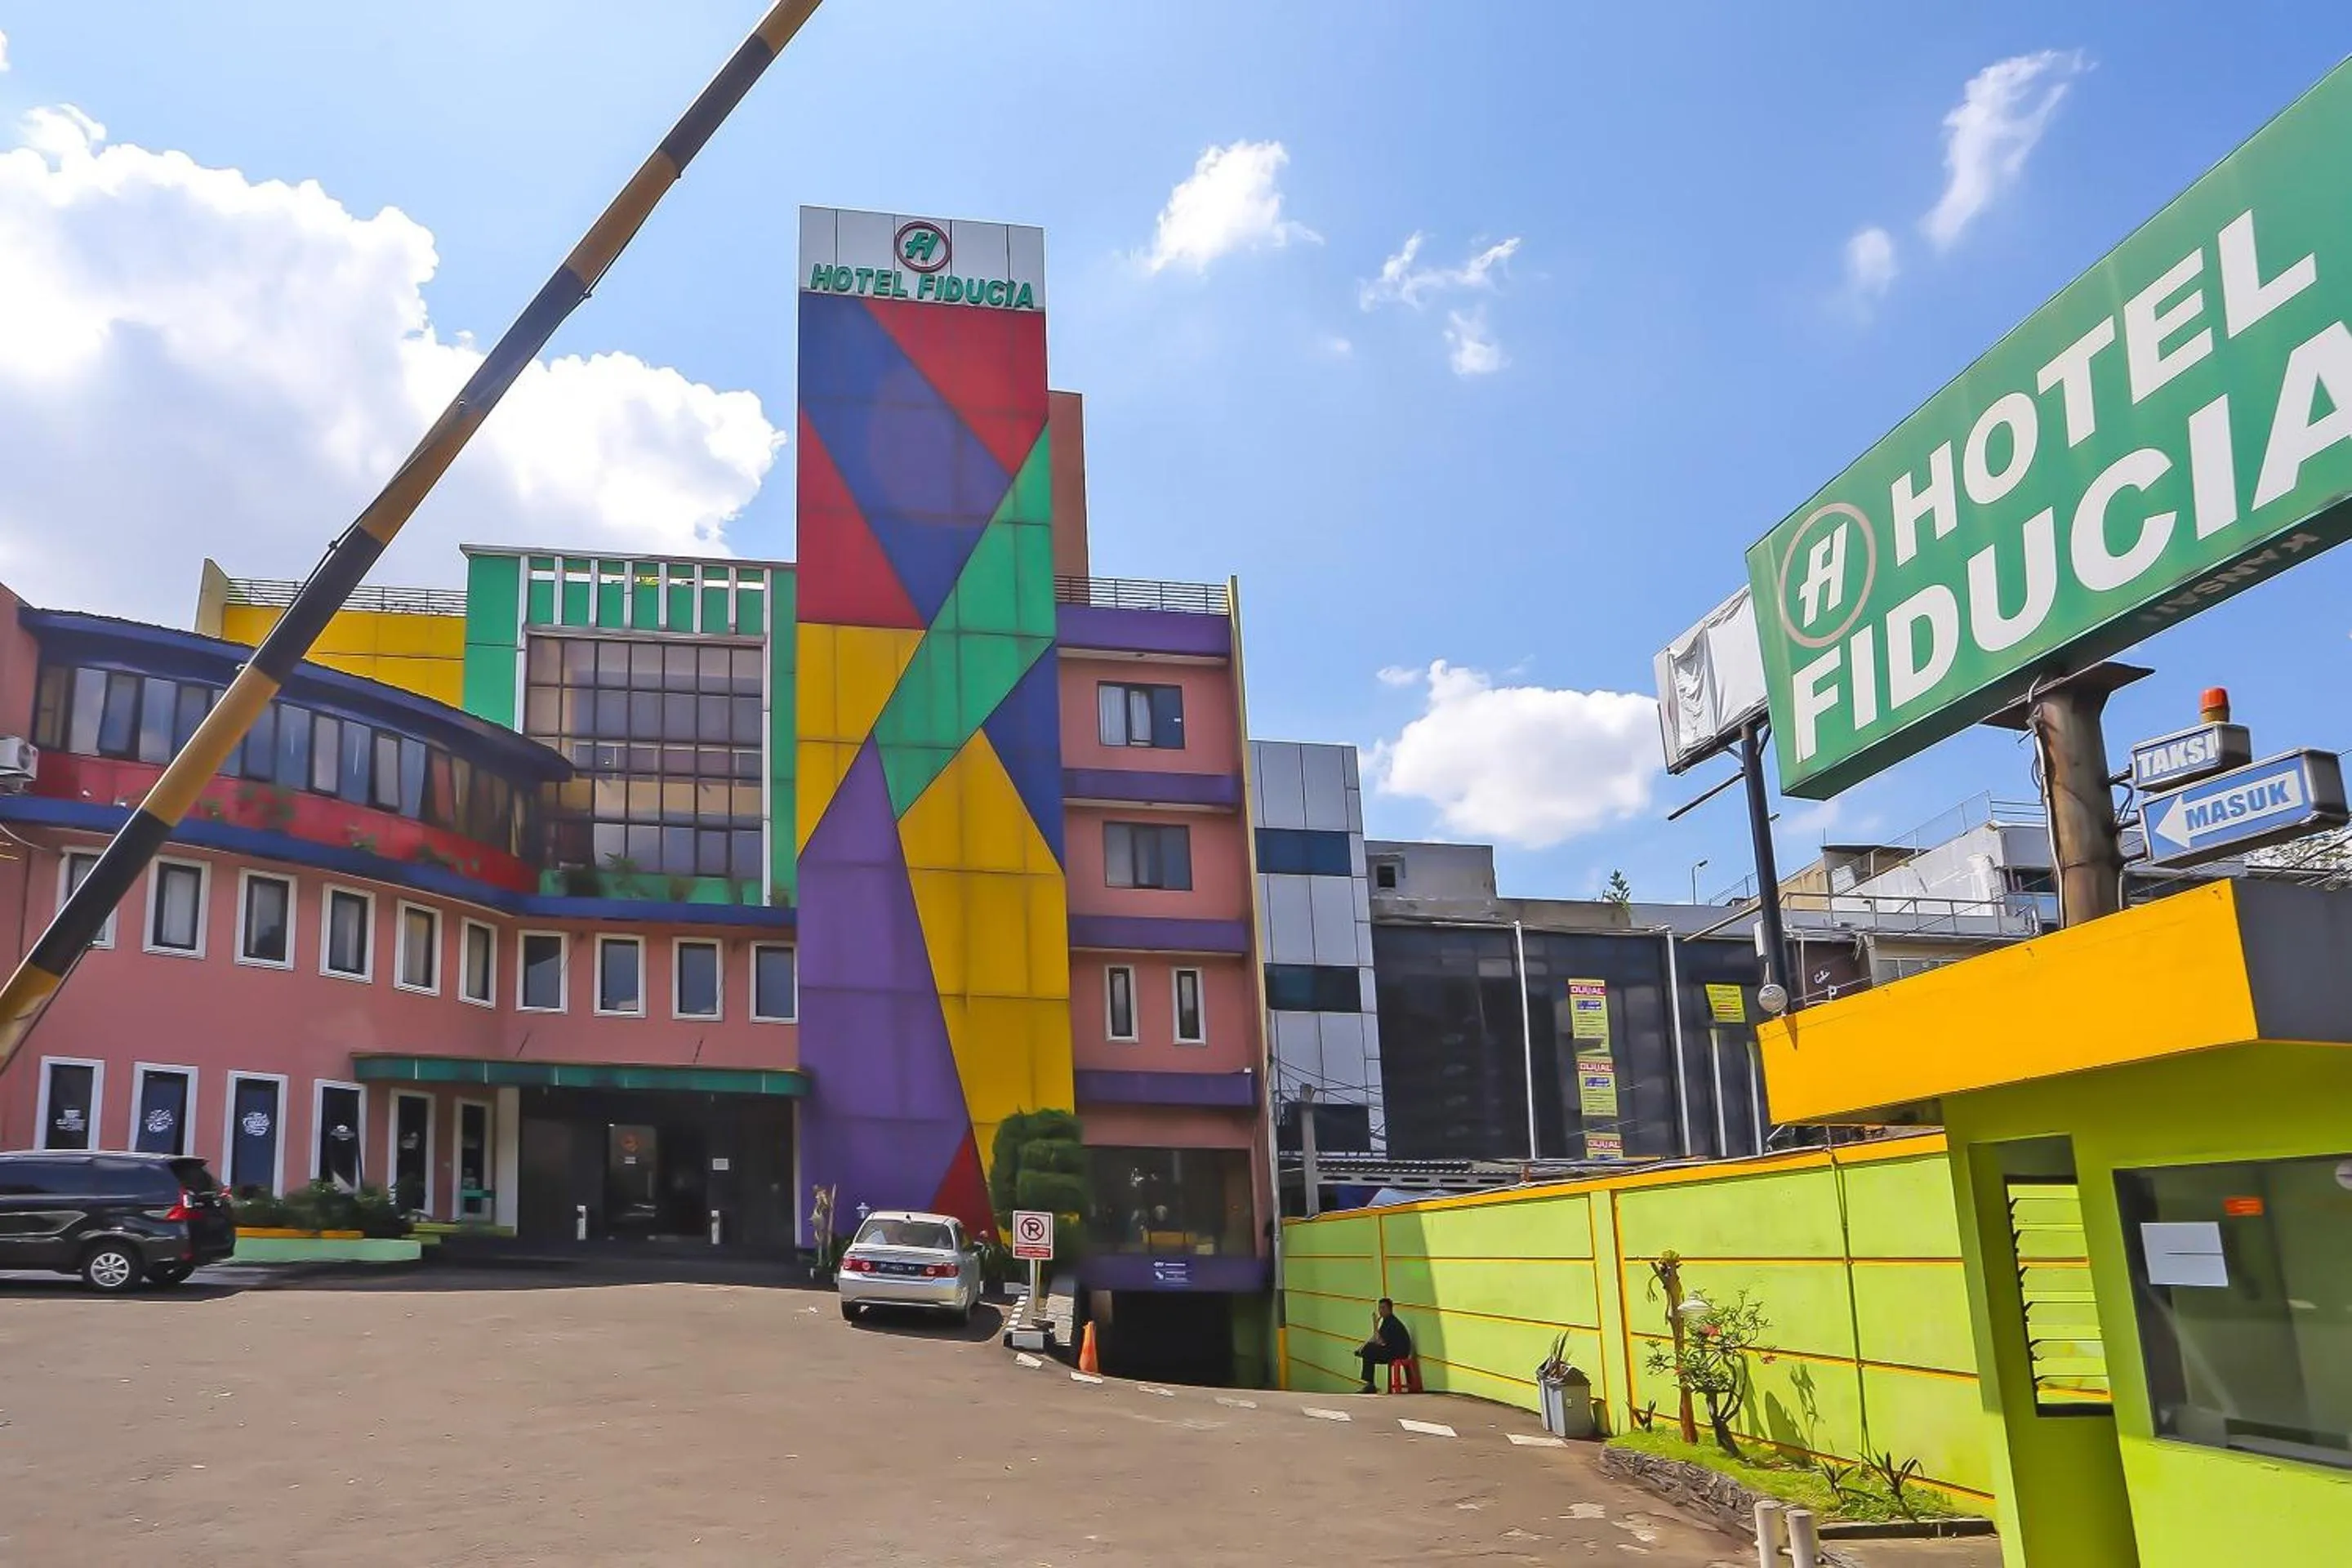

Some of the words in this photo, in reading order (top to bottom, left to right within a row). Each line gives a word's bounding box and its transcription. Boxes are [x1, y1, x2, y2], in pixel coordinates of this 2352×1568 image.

[810, 263, 909, 297] HOTEL
[917, 274, 1035, 310] FIDUCIA
[1890, 208, 2318, 567] HOTEL
[1793, 320, 2352, 764] FIDUCIA
[2137, 733, 2218, 777] TAKSI
[2185, 780, 2291, 832] MASUK
